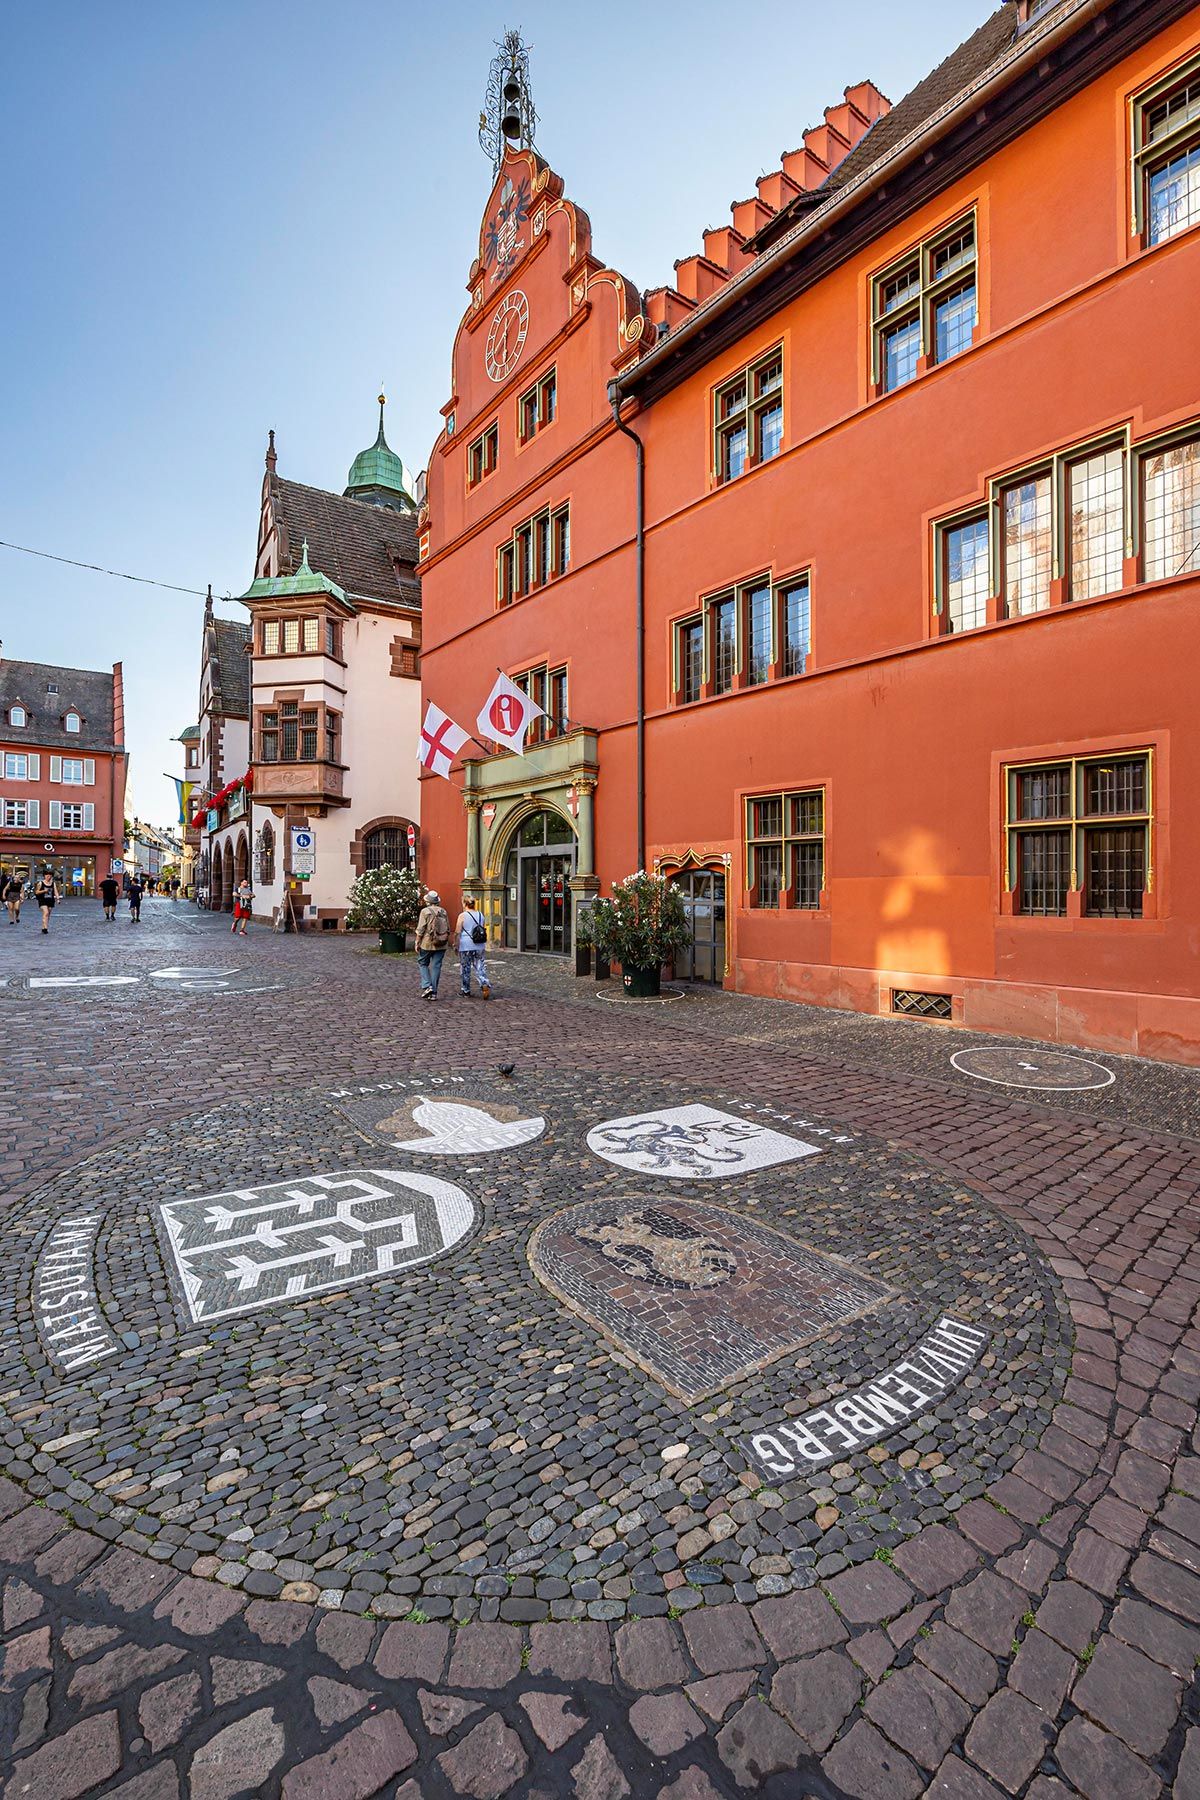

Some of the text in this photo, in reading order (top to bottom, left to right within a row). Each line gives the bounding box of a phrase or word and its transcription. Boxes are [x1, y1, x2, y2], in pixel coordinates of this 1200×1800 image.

[330, 1076, 465, 1098] MADISON
[727, 1099, 854, 1142] ISFAHAN
[40, 1215, 118, 1370] MATSUYAMA
